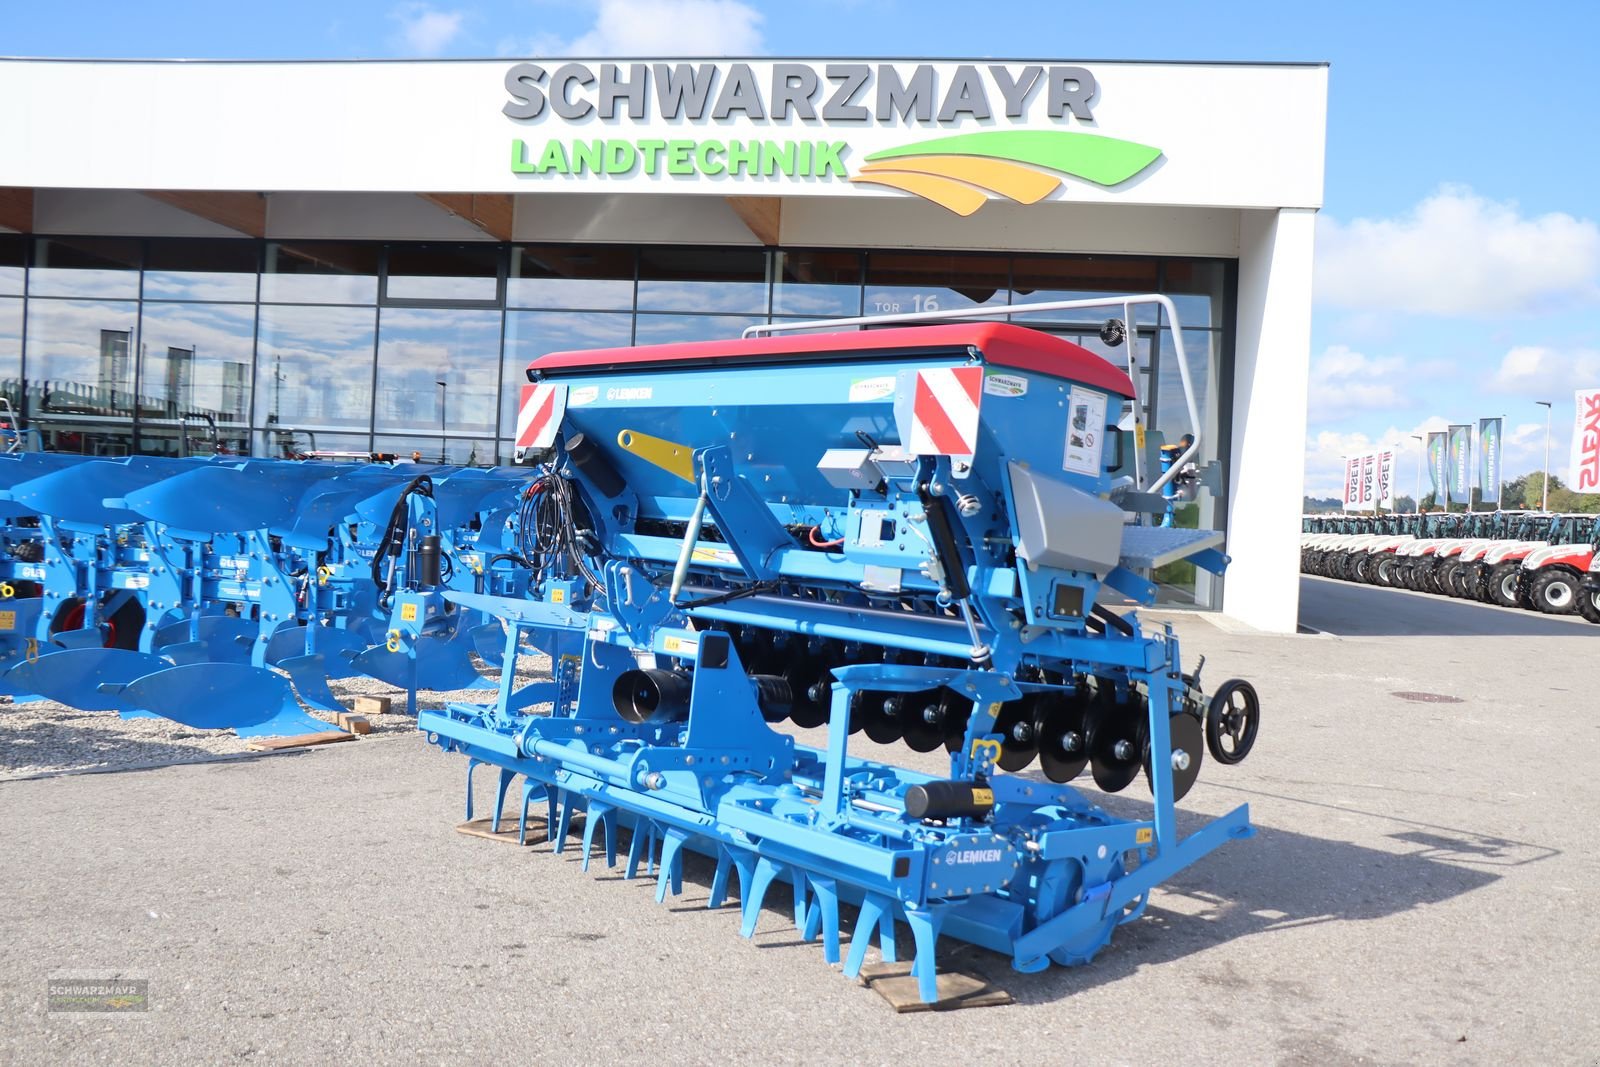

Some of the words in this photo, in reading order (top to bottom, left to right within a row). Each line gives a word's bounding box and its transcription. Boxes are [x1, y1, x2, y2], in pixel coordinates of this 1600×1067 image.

[501, 62, 1097, 122] SCHWARZMAYR
[510, 139, 848, 177] LANDTECHNIK
[874, 302, 900, 313] TOR
[912, 294, 939, 313] 16
[614, 387, 653, 401] LEMKEN
[956, 849, 1002, 865] LEMKEN
